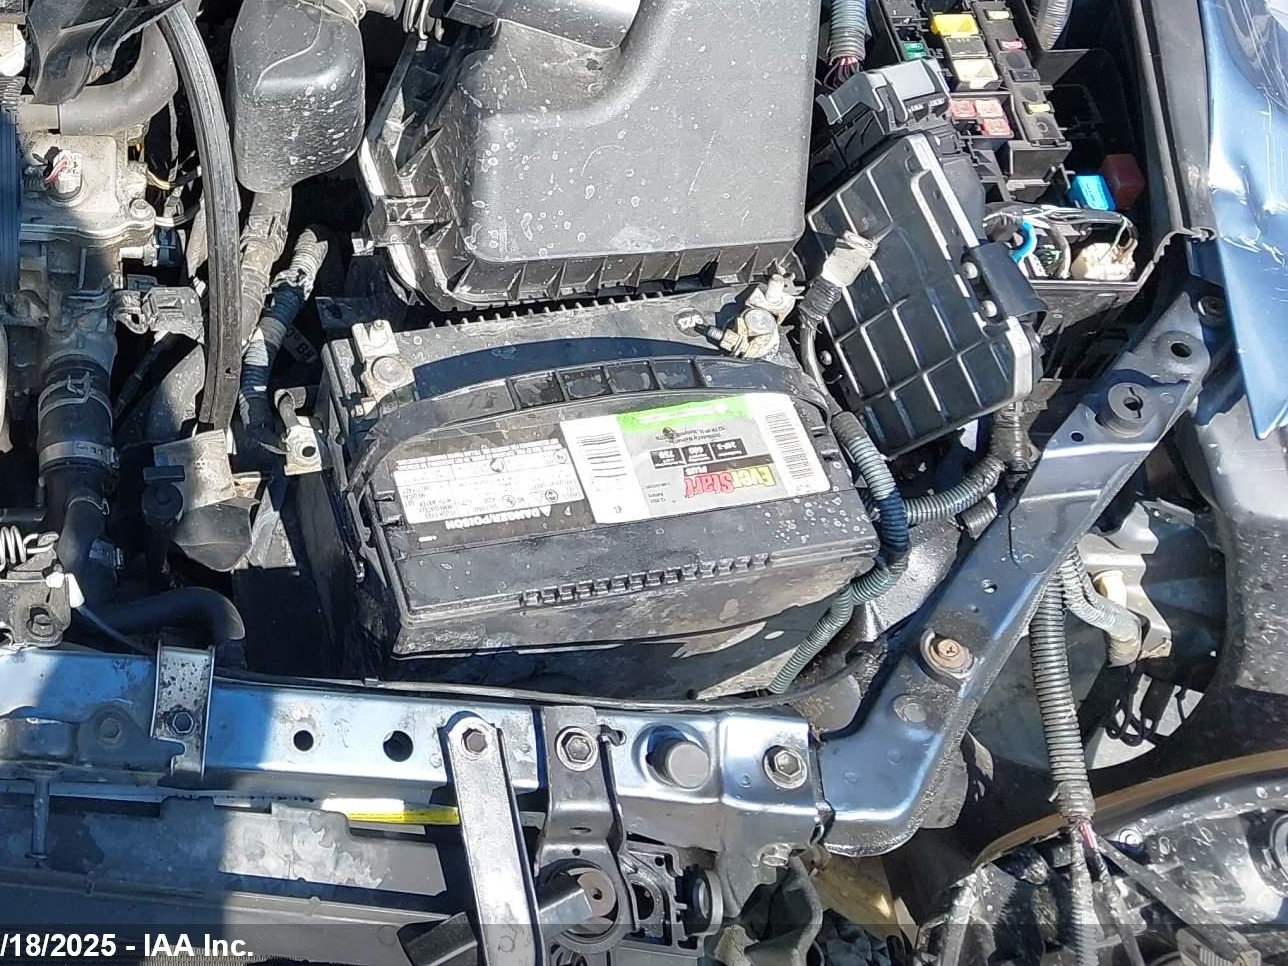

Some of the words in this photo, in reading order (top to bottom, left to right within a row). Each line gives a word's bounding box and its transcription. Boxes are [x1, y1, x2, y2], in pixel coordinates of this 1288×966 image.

[684, 465, 776, 498] EverStart
[685, 465, 708, 476] PLUS
[444, 506, 541, 530] DANGER/POISON
